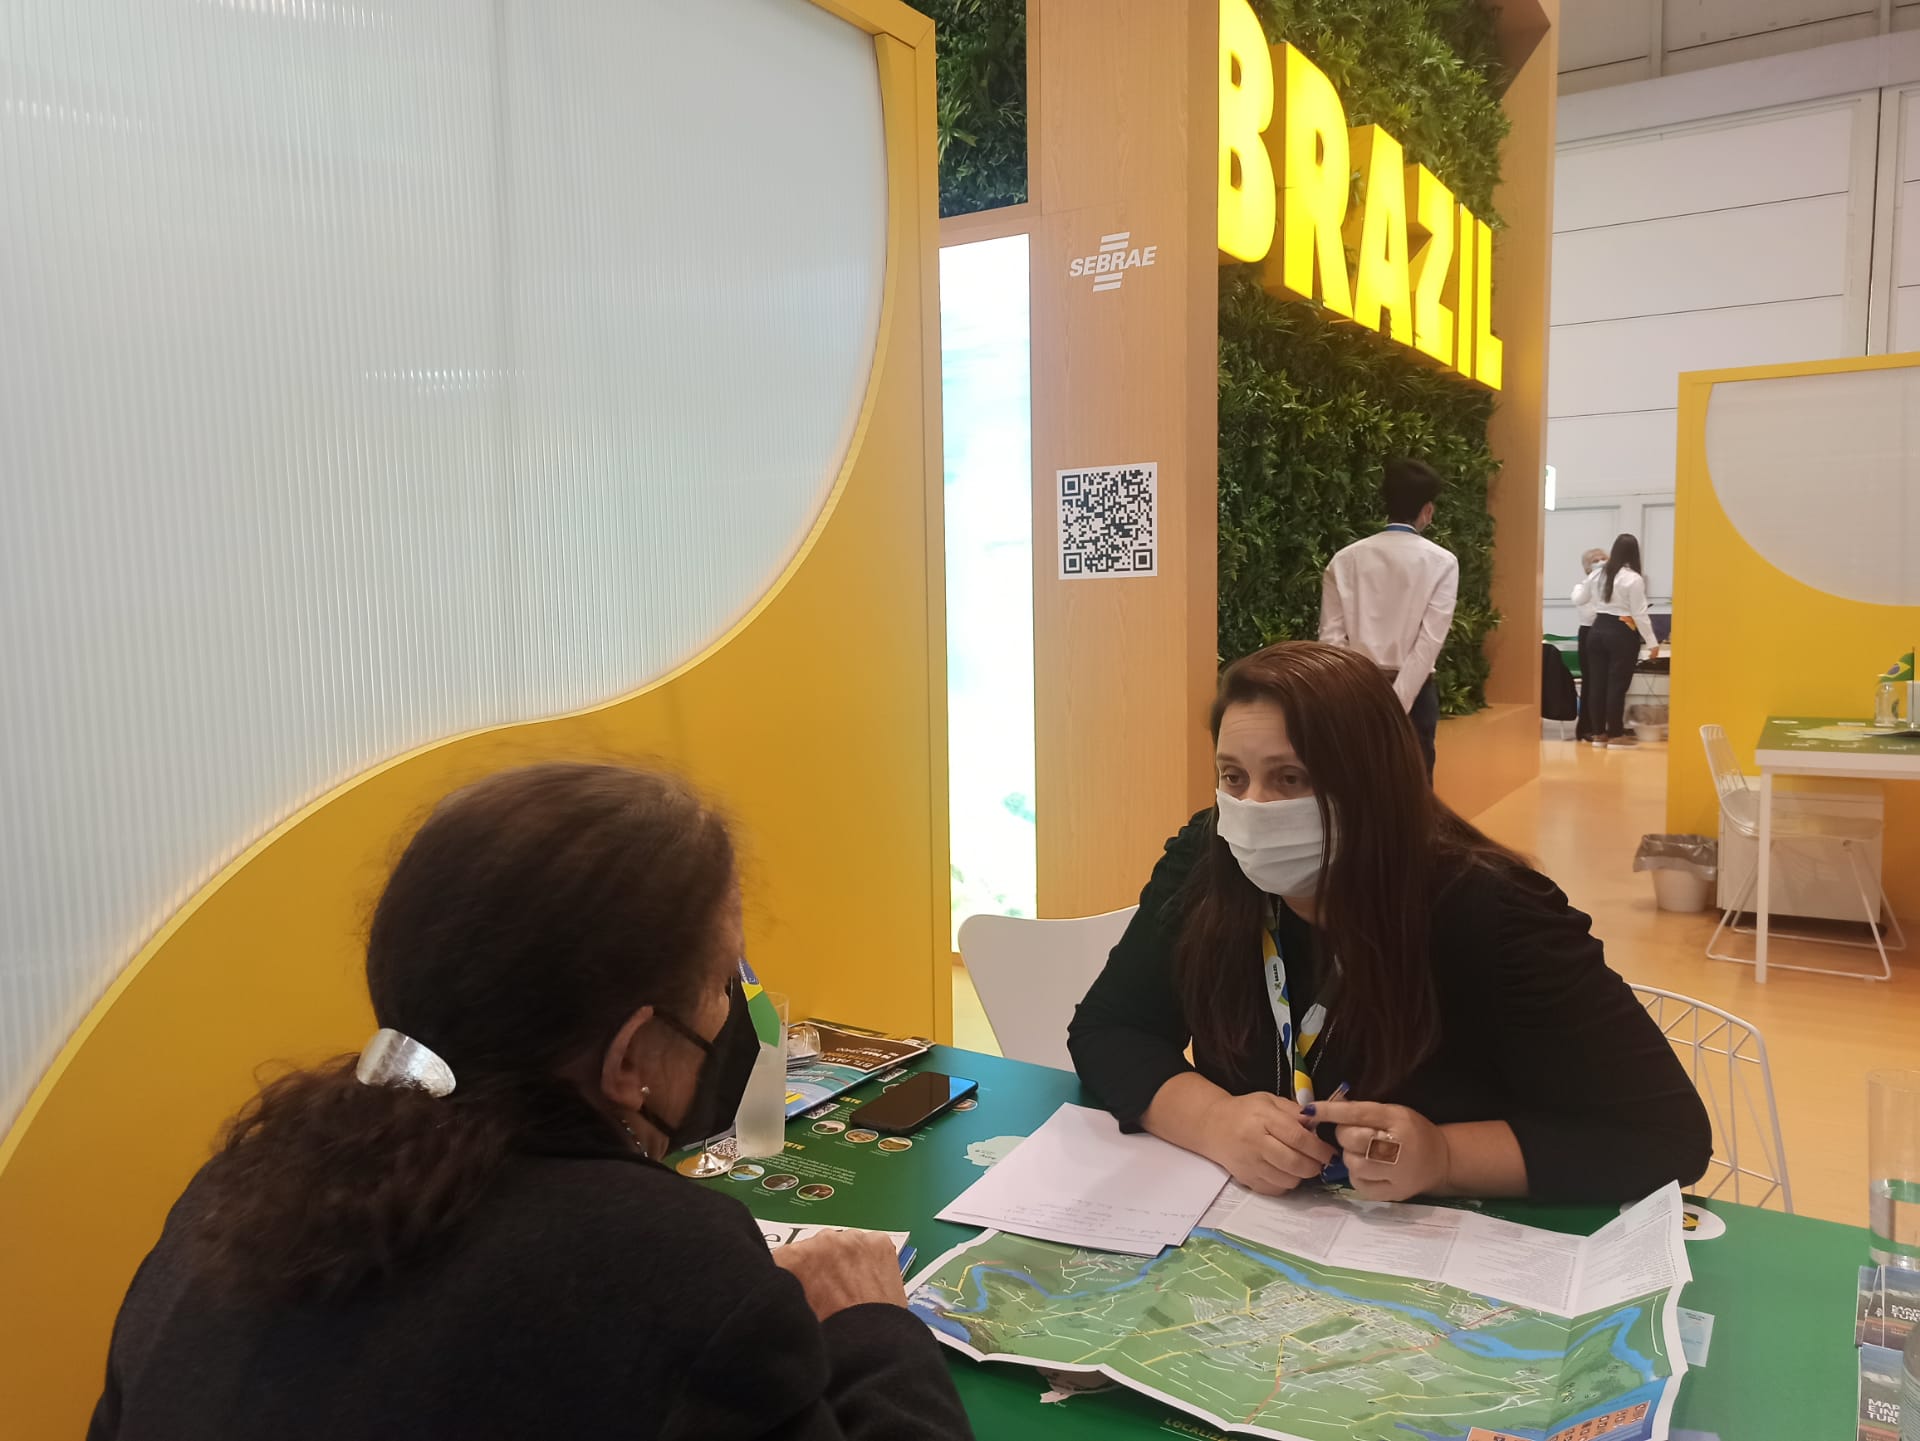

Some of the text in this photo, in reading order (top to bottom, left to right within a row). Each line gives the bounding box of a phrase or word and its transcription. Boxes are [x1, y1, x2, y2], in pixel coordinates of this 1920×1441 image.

[1218, 0, 1503, 391] BRAZIL
[1069, 245, 1158, 277] SEBRAE
[1868, 1398, 1900, 1410] MAP
[1867, 1411, 1898, 1425] TUR
